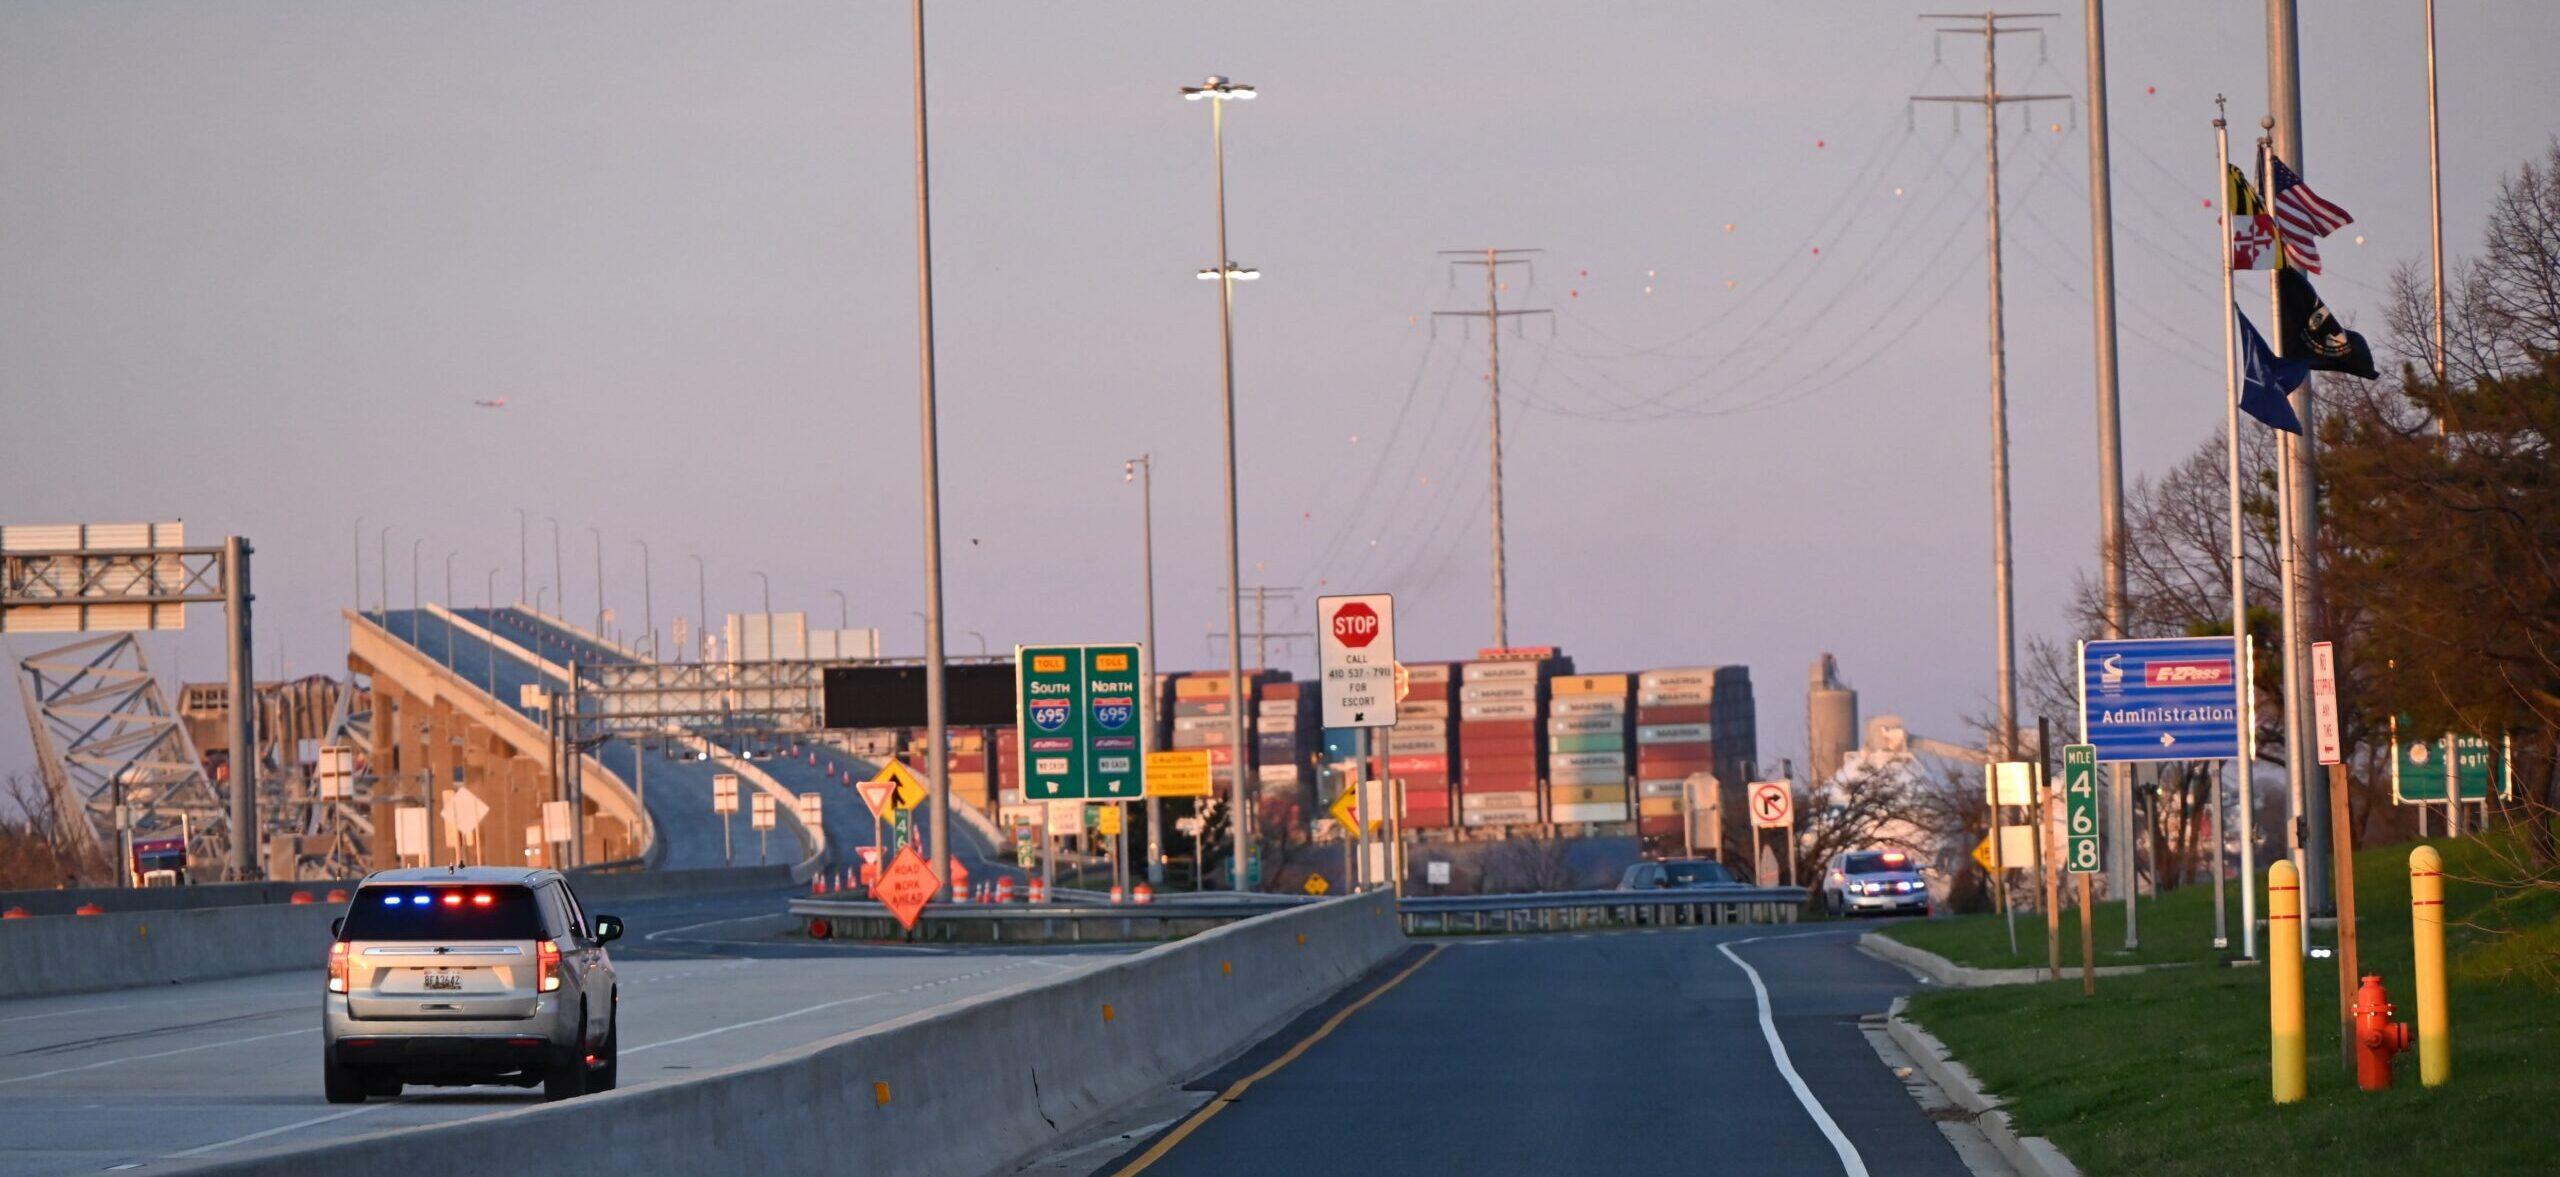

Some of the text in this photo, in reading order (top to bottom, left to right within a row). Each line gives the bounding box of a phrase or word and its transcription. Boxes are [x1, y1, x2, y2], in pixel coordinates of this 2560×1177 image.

[1335, 616, 1376, 634] STOP
[1037, 659, 1062, 668] TOLL
[1100, 658, 1124, 667] TOLL
[1346, 655, 1368, 664] CALL
[1329, 669, 1344, 678] 410
[2156, 666, 2221, 682] E-ZPass
[1349, 683, 1367, 692] FOR
[1342, 697, 1376, 707] ESCORT
[1036, 709, 1065, 723] 695
[1099, 707, 1128, 721] 695
[2102, 706, 2234, 724] Administration
[2068, 751, 2092, 764] MILE
[895, 865, 920, 874] ROAD
[895, 881, 920, 891] WORK
[892, 893, 923, 905] AHEAD
